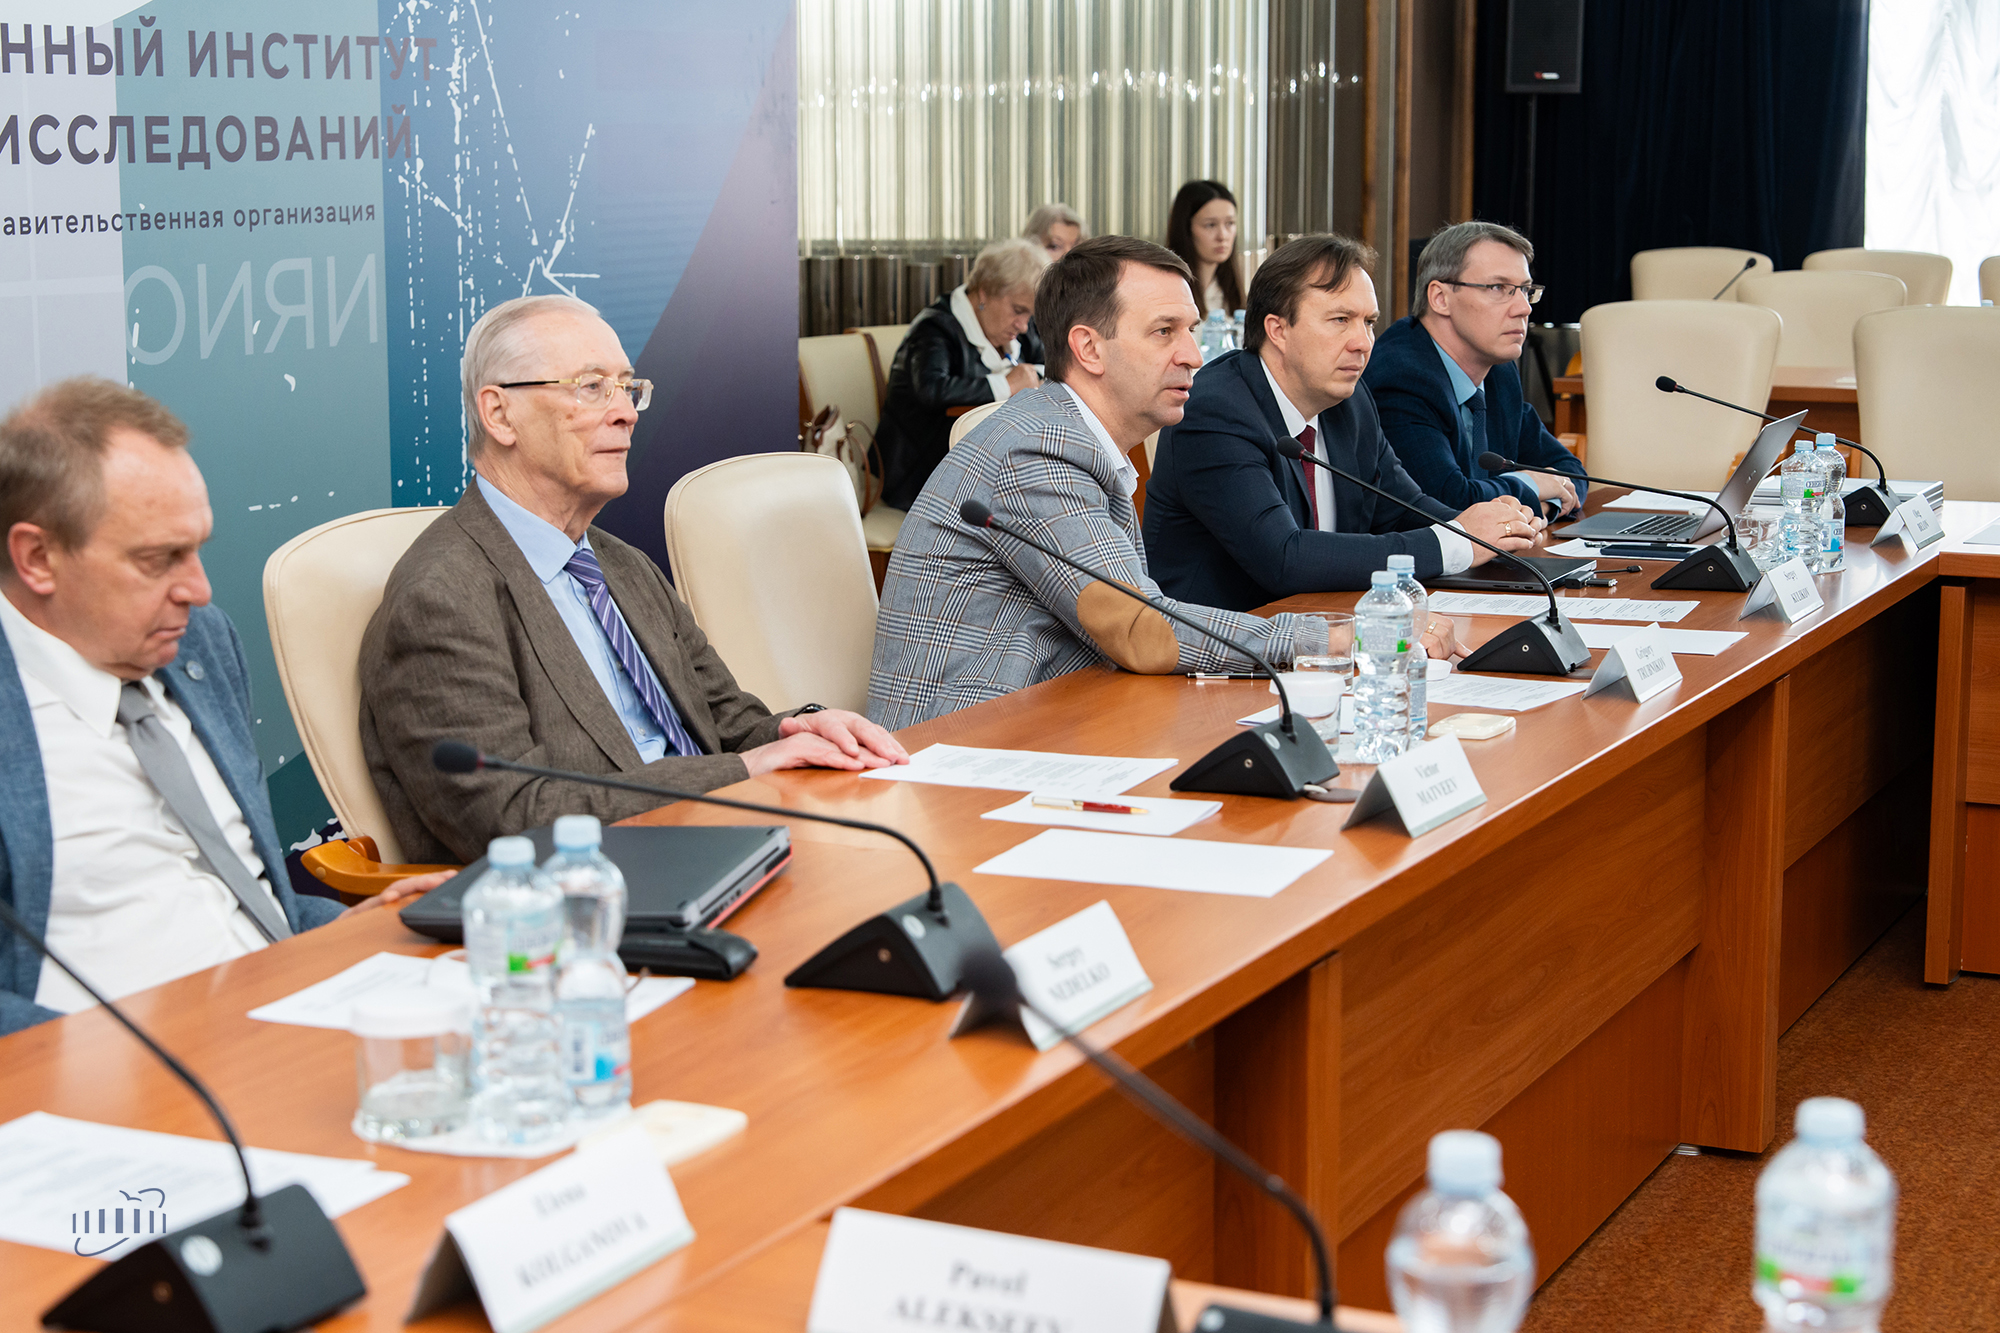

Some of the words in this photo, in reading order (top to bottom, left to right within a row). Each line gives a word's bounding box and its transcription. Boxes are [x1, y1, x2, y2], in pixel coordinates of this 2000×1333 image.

[0, 16, 164, 76] ННЫЙ
[188, 30, 438, 81] ИНСТИТУТ
[0, 104, 412, 170] ИССЛЕДОВАНИЙ
[3, 207, 225, 236] авительственная
[233, 203, 376, 232] организация
[125, 253, 379, 366] ОИЯИ
[1637, 656, 1667, 680] TRUBNIKOV
[1414, 762, 1440, 778] Victor
[1416, 776, 1458, 806] MATVEEV
